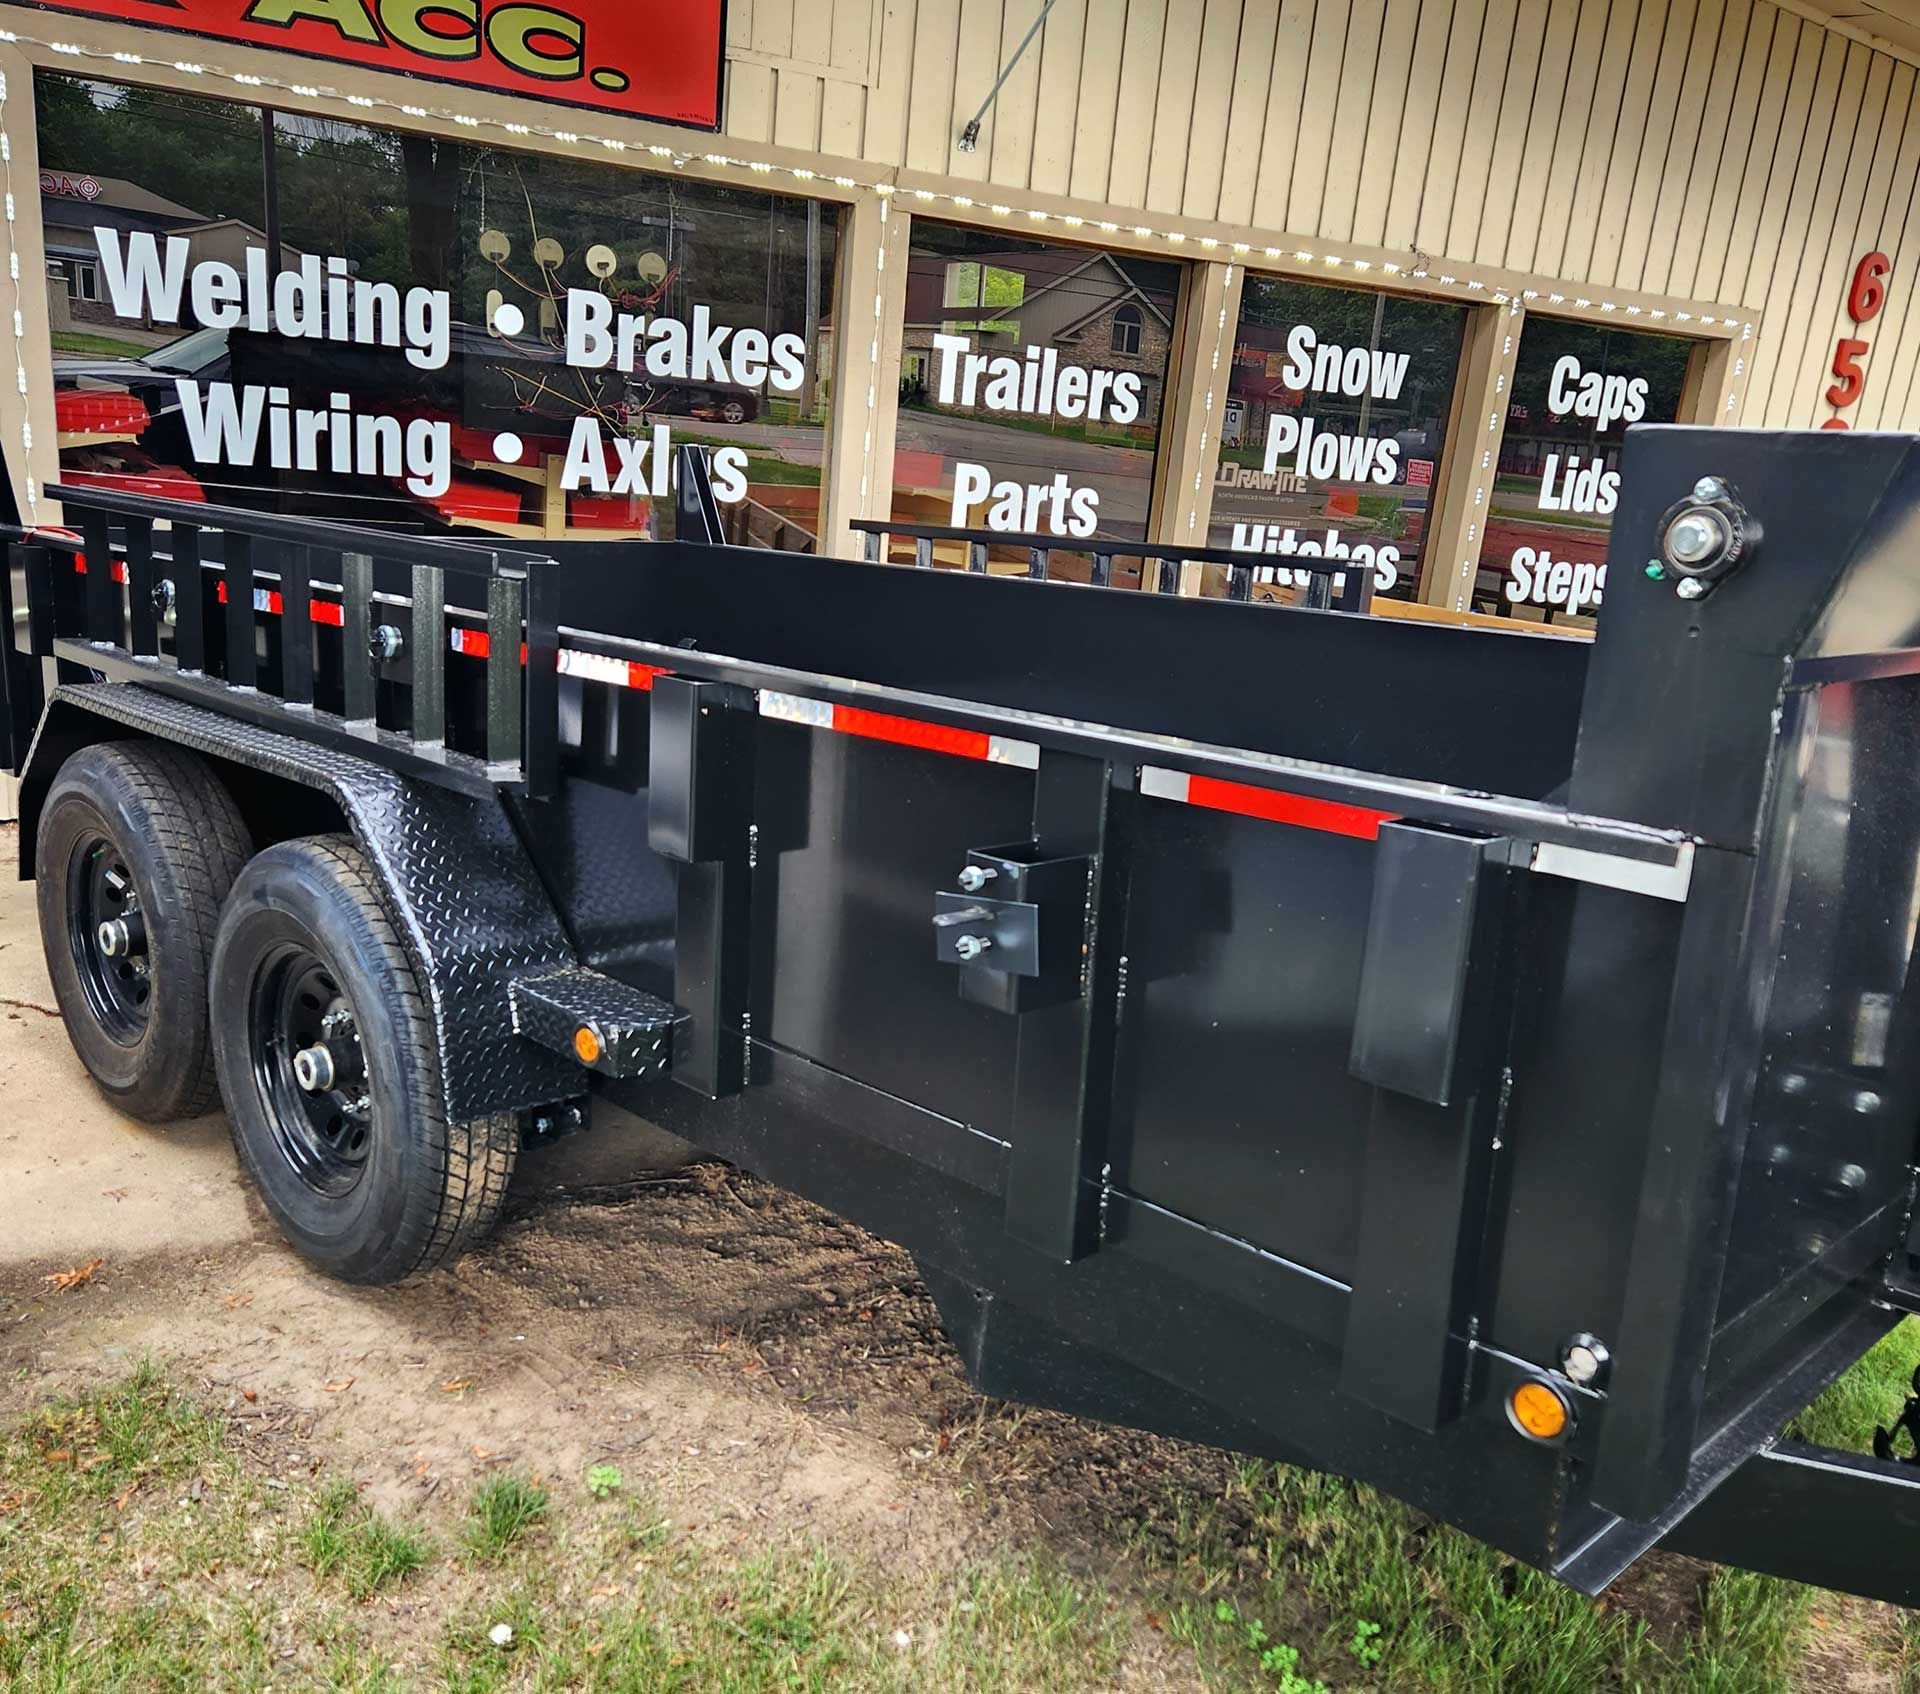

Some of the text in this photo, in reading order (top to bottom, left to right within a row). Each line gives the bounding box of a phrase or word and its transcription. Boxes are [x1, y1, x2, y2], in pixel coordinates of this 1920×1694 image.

[93, 226, 806, 391] Welding Brakes
[1820, 251, 1890, 429] 65
[933, 333, 1141, 424] Trailers
[1282, 325, 1411, 400] Snow
[1548, 355, 1649, 432] Caps
[175, 379, 749, 503] Wiring Axls
[1262, 413, 1400, 485] Plows
[950, 462, 1099, 538] Parts
[1537, 453, 1621, 514] Lids
